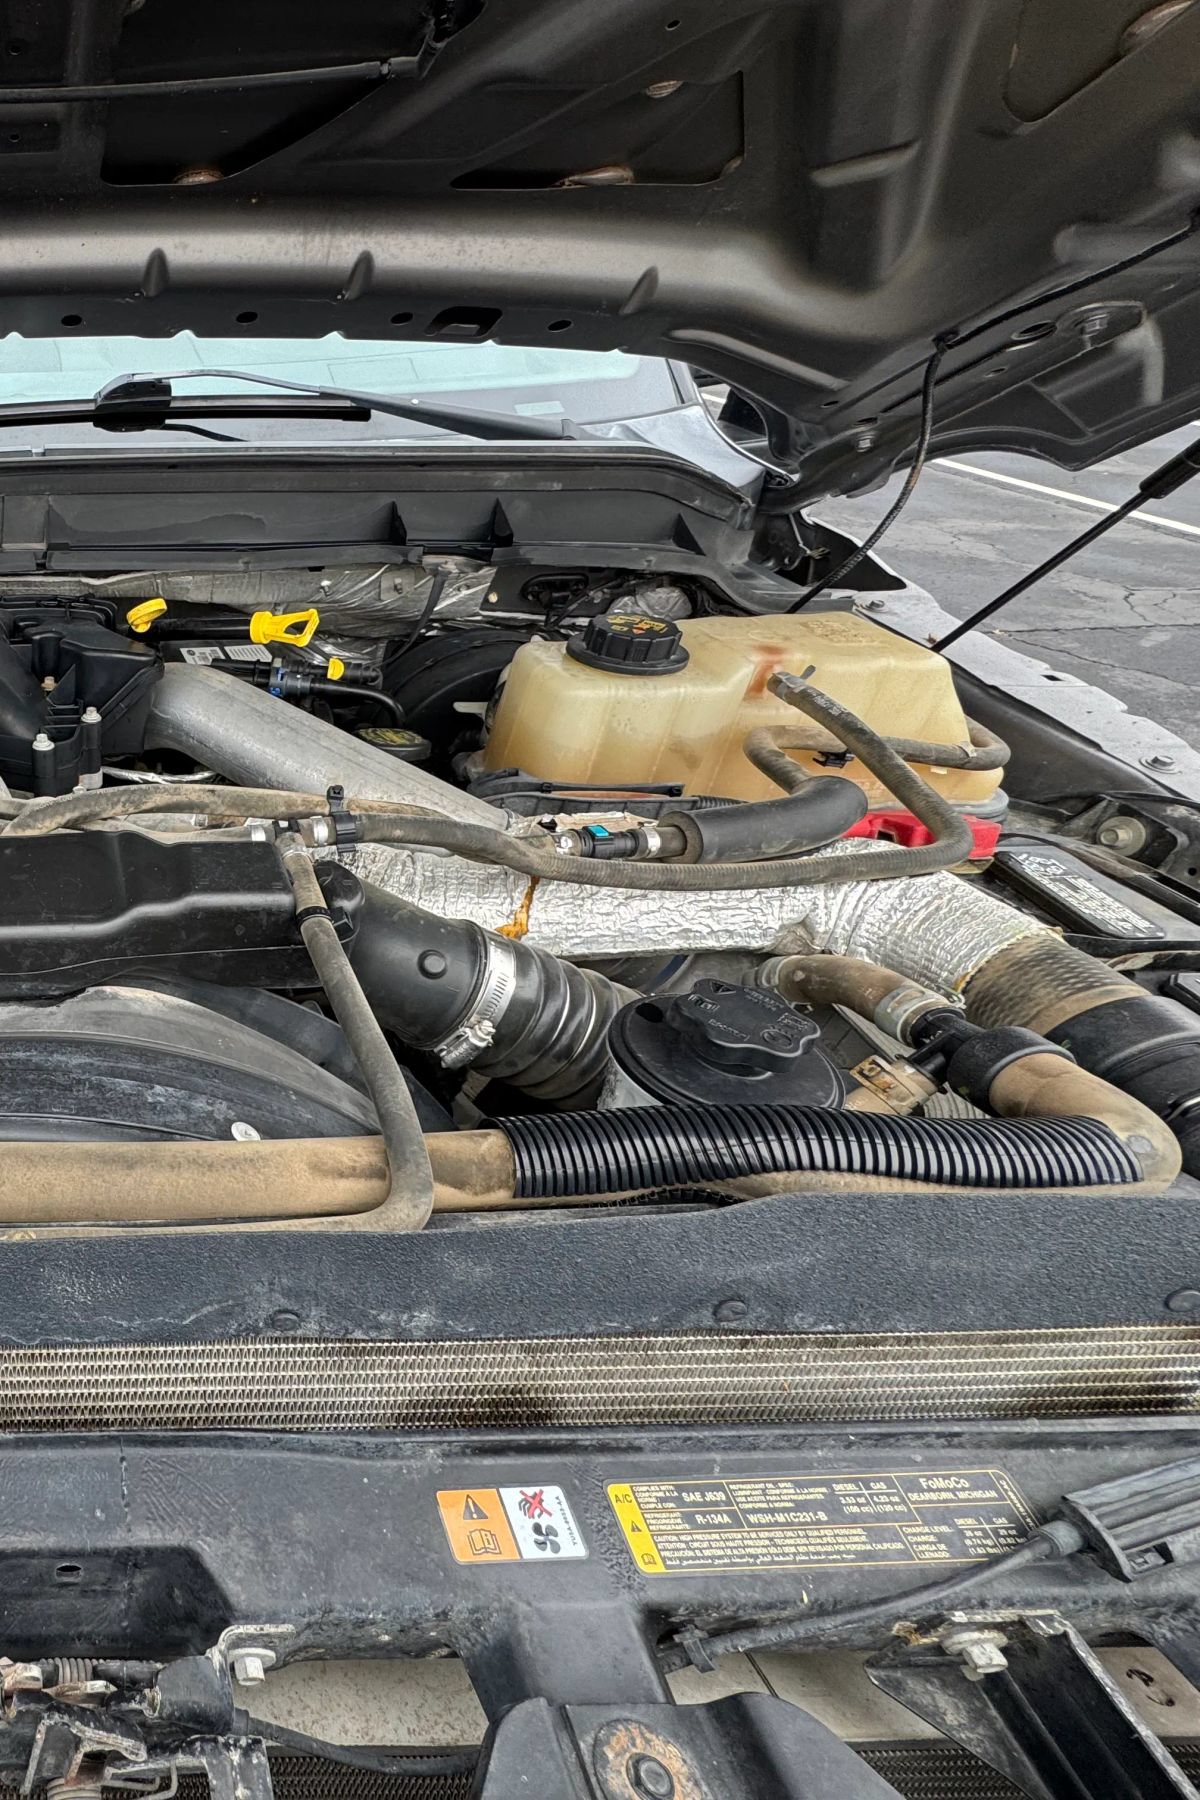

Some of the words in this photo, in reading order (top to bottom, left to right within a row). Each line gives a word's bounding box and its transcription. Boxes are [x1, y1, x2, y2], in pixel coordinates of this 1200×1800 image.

[831, 1483, 859, 1491] DIESEL
[870, 1481, 887, 1490] GAS
[918, 1477, 970, 1490] FoMoCo
[614, 1493, 633, 1504] A/C
[681, 1492, 704, 1502] SAE
[704, 1491, 726, 1501] J639
[907, 1492, 958, 1502] DEARBORN,
[957, 1489, 999, 1499] MICHIGAN
[694, 1513, 733, 1525] R-134A
[746, 1511, 828, 1524] WSH-M1C231-B
[953, 1517, 979, 1525] DIESEL
[902, 1526, 932, 1534] CHARGE
[932, 1525, 955, 1533] LEVEL:
[907, 1535, 939, 1543] CHARGE:
[912, 1544, 938, 1552] CARGA
[937, 1543, 948, 1551] DE
